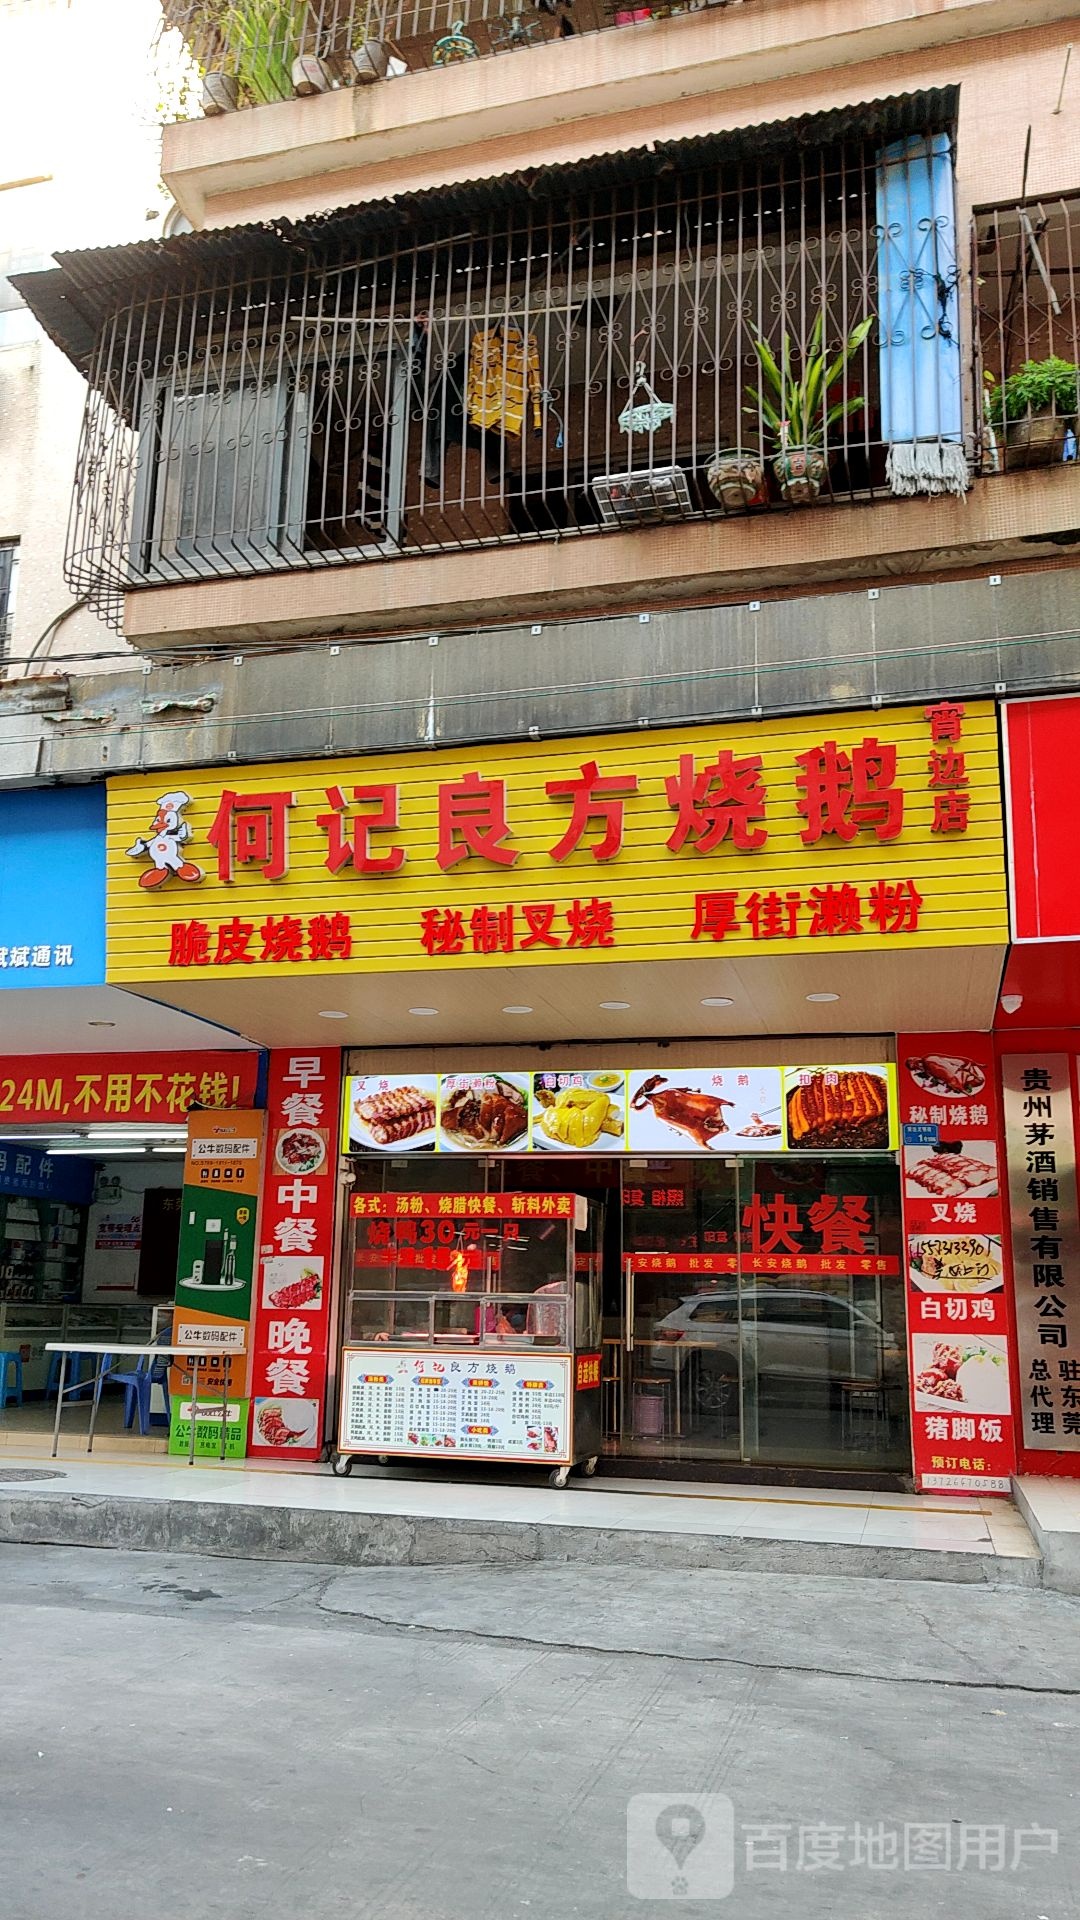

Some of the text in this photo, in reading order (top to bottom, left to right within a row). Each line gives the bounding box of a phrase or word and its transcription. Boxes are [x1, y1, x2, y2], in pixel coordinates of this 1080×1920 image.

[924, 702, 971, 834] 宵边店
[207, 738, 906, 885] 何记良方烧鹅
[168, 880, 923, 967] 脆皮烧鹅 秘制叉烧 厚街濑粉
[909, 1104, 989, 1126] 秘制烧鹅
[199, 1143, 250, 1155] 公牛数码配件
[742, 1193, 872, 1254] 快餐
[930, 1203, 977, 1223] 叉烧
[752, 1257, 887, 1271] 长安烧鹅 批发 零售
[920, 1297, 996, 1322] 白切鸡
[184, 1329, 238, 1343] 公牛数码配件
[924, 1416, 1005, 1443] 猪脚饭
